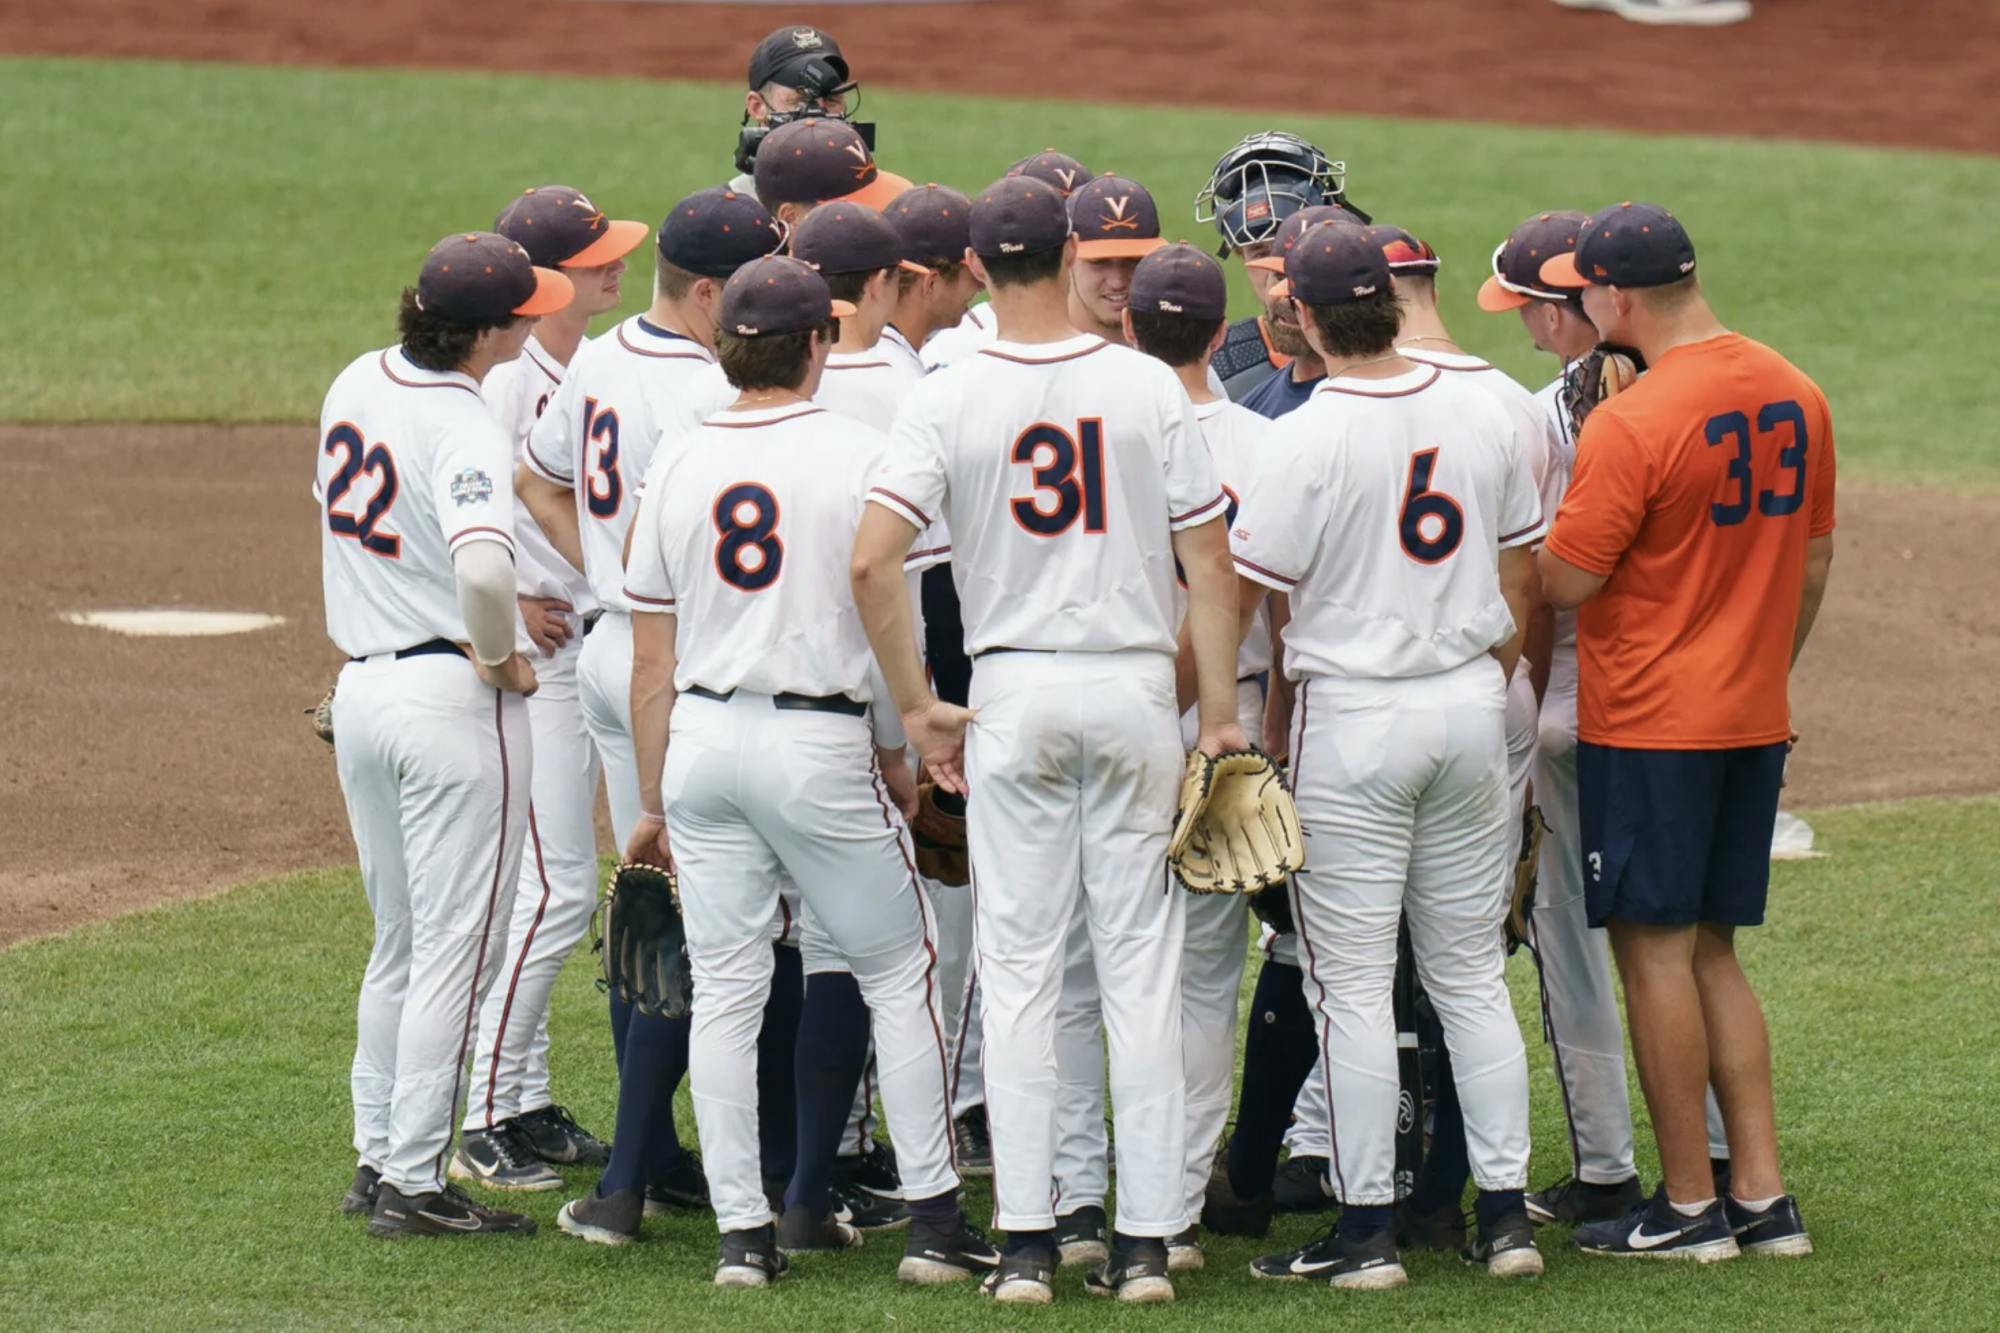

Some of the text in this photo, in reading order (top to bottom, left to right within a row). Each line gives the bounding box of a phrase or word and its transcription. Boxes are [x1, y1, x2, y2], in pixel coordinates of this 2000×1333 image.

[1053, 168, 1077, 190] V
[1103, 196, 1129, 220] V
[325, 421, 401, 560] 22
[581, 396, 622, 519] 13
[1009, 416, 1107, 537] 31
[1398, 446, 1465, 565] 6
[1704, 400, 1808, 527] 33
[712, 480, 784, 593] 8
